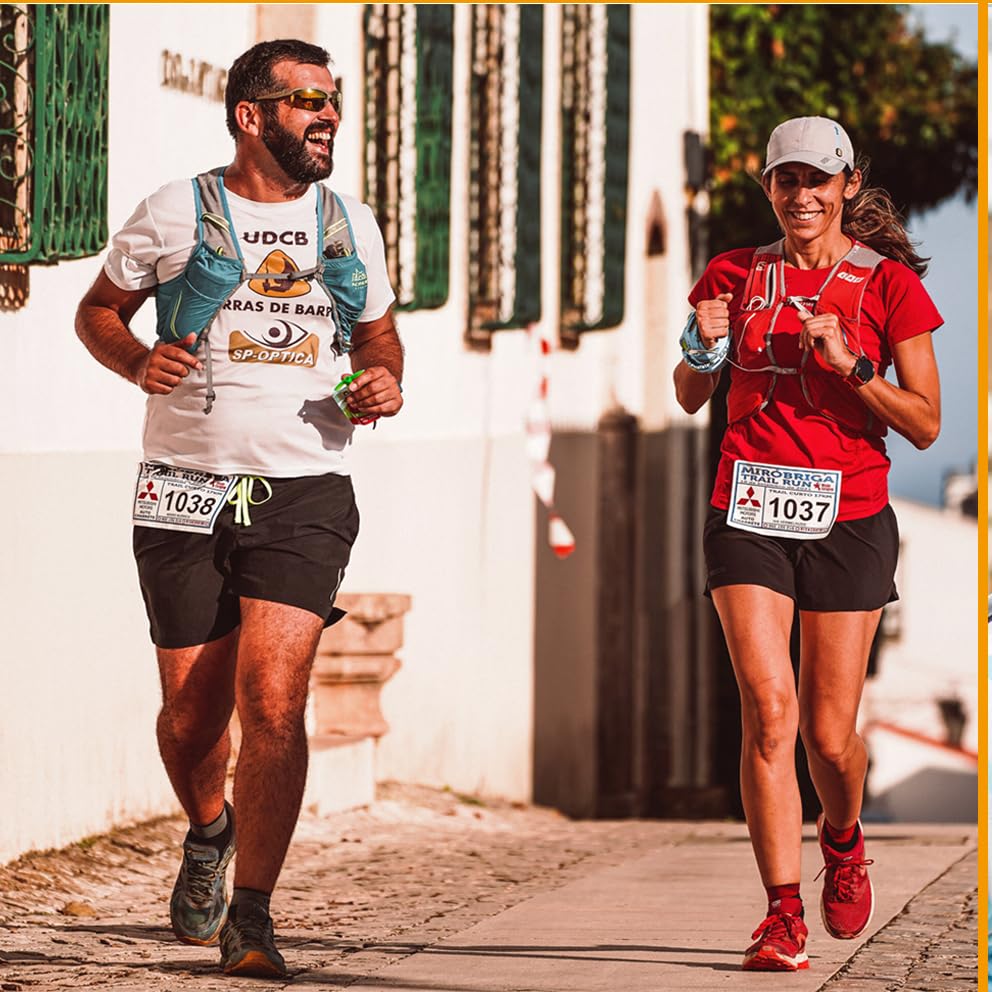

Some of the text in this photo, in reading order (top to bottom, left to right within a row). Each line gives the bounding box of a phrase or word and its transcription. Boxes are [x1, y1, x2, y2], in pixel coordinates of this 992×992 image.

[241, 230, 309, 246] UDCB
[270, 302, 290, 314] DE
[232, 349, 315, 365] SP-OPTICA
[741, 474, 778, 484] TRAIL
[783, 479, 812, 488] RUN
[165, 490, 216, 515] 1038
[769, 497, 830, 522] 1037
